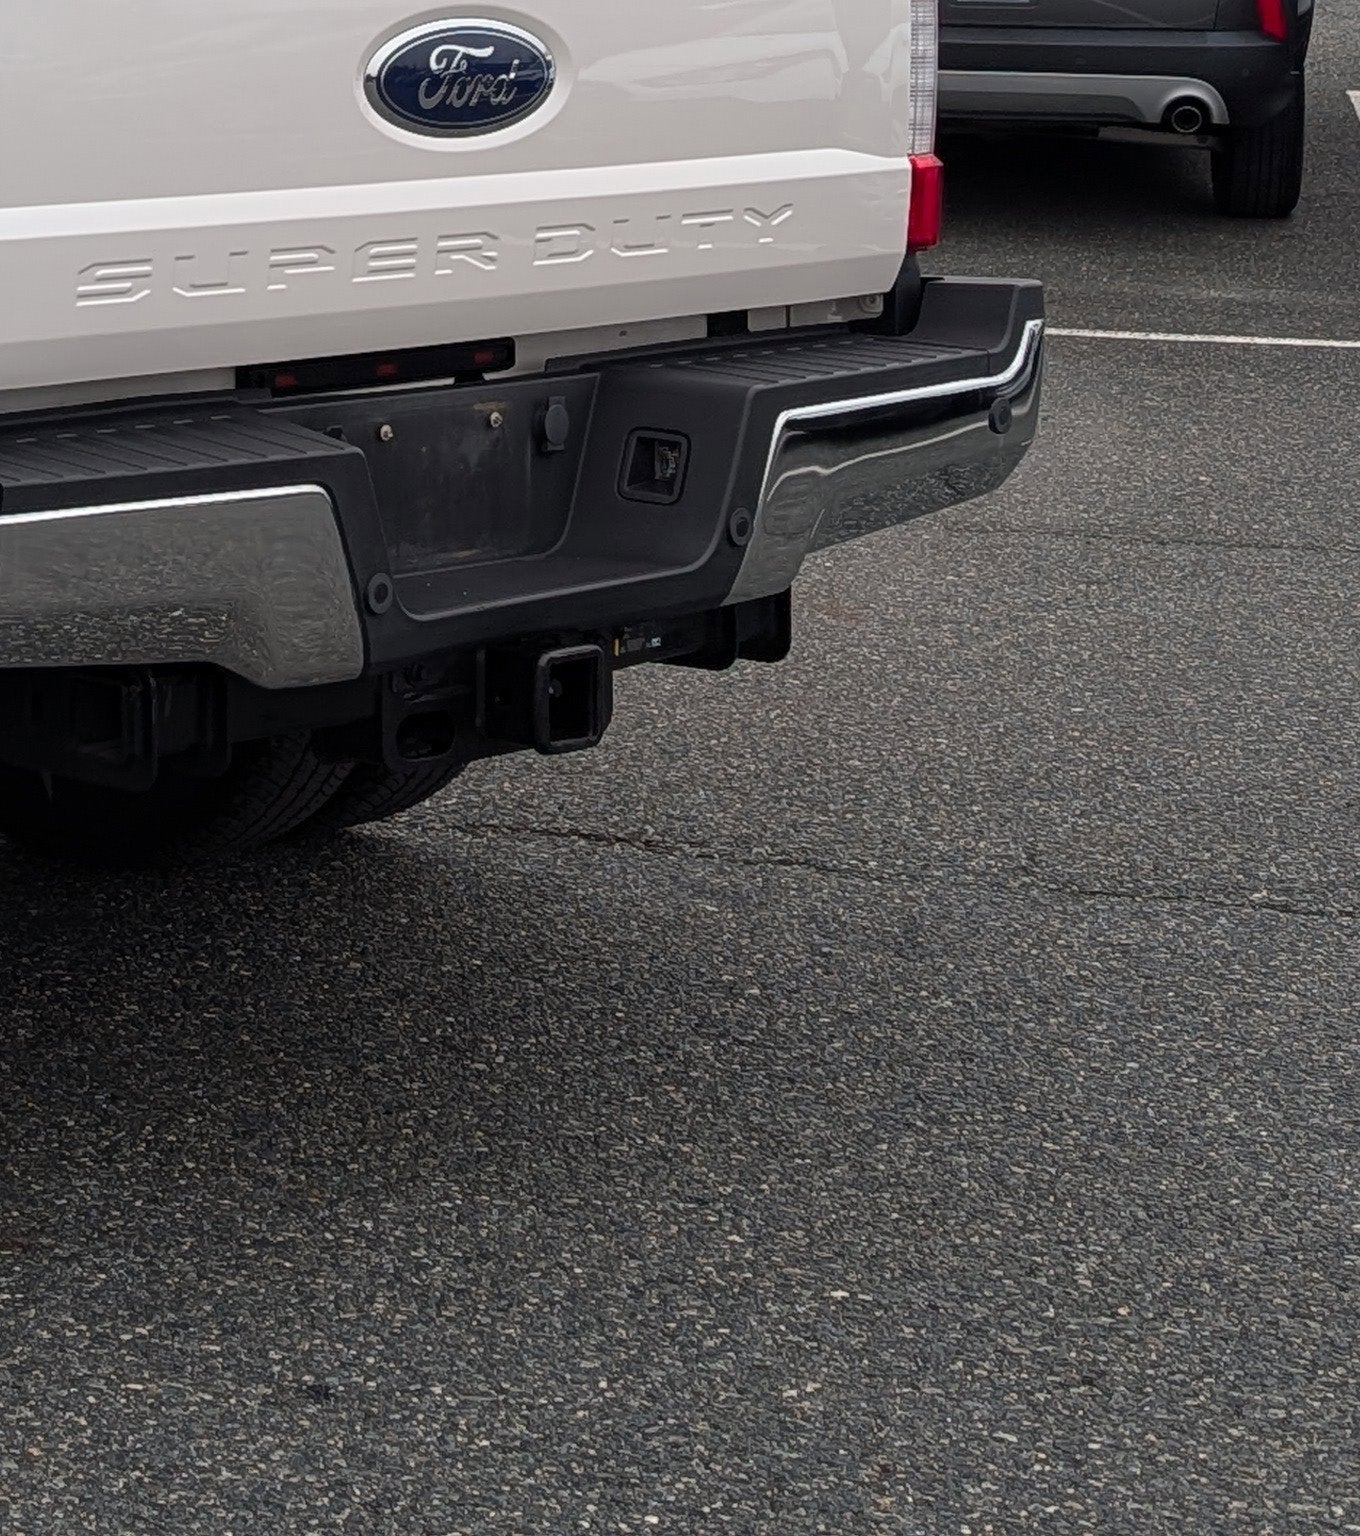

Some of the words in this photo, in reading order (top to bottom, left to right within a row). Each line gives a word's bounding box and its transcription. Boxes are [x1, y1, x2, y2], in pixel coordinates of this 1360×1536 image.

[418, 44, 520, 110] Ford
[76, 230, 498, 307] SUPER
[532, 202, 794, 267] DUTY
